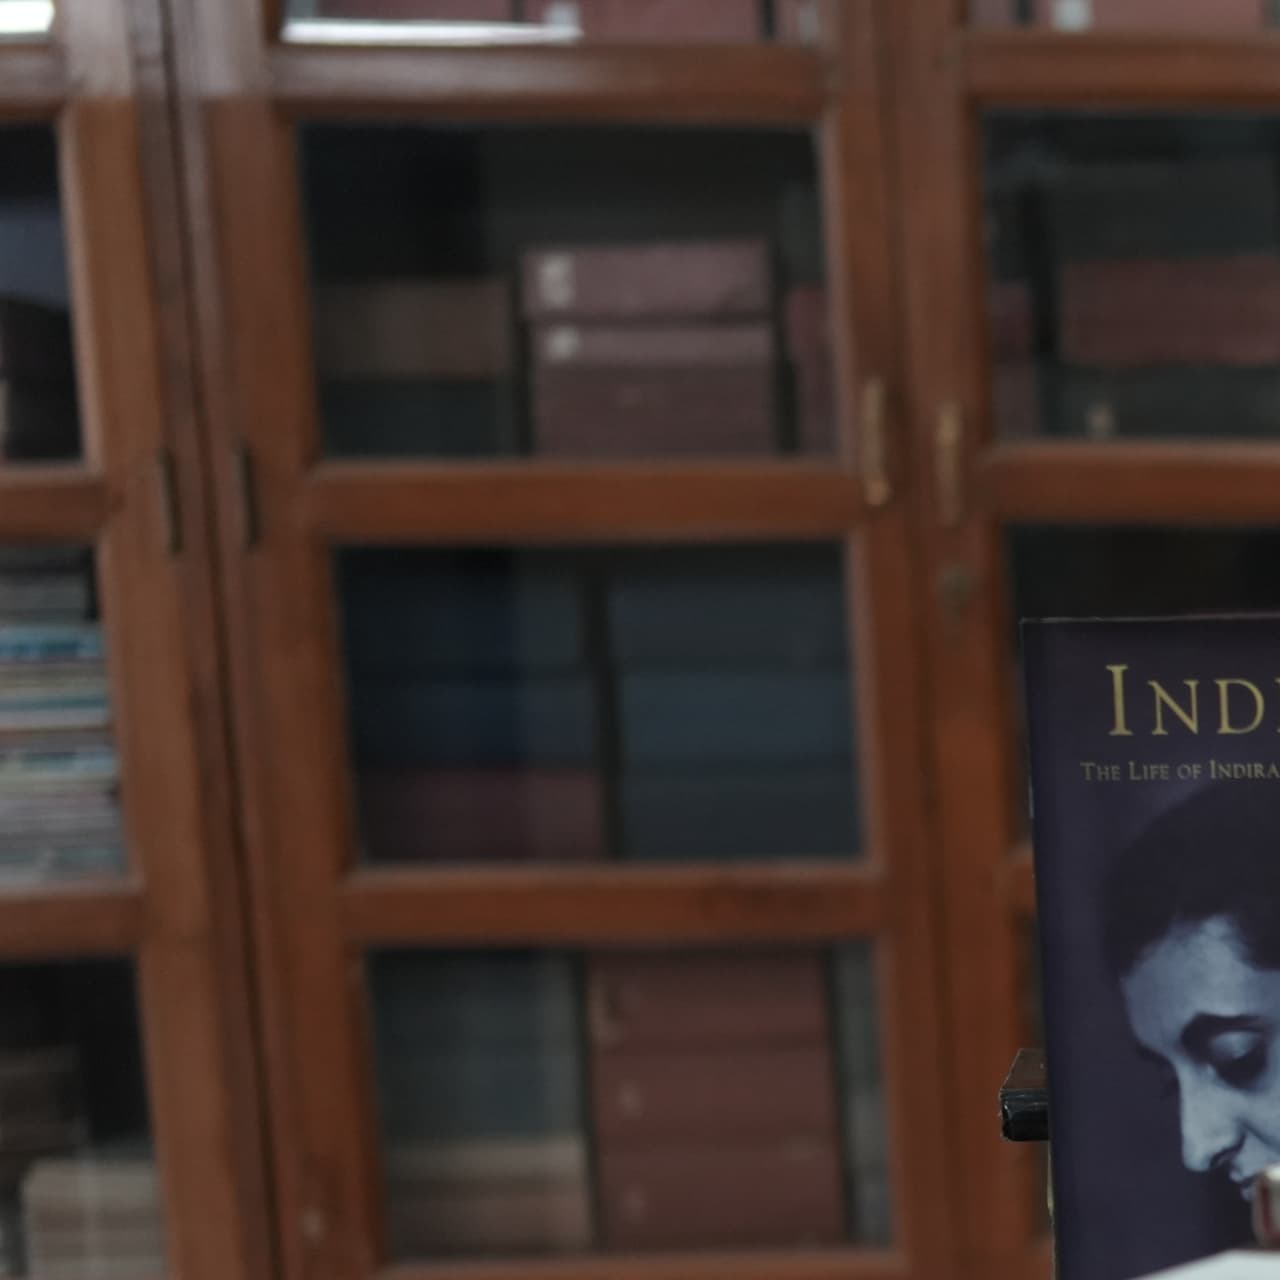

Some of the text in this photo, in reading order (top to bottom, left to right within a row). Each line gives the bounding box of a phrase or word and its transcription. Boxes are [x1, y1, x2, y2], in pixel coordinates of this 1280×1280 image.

[1080, 761, 1121, 782] THE
[1128, 761, 1170, 782] LIFE
[1209, 759, 1280, 780] INDIRA
